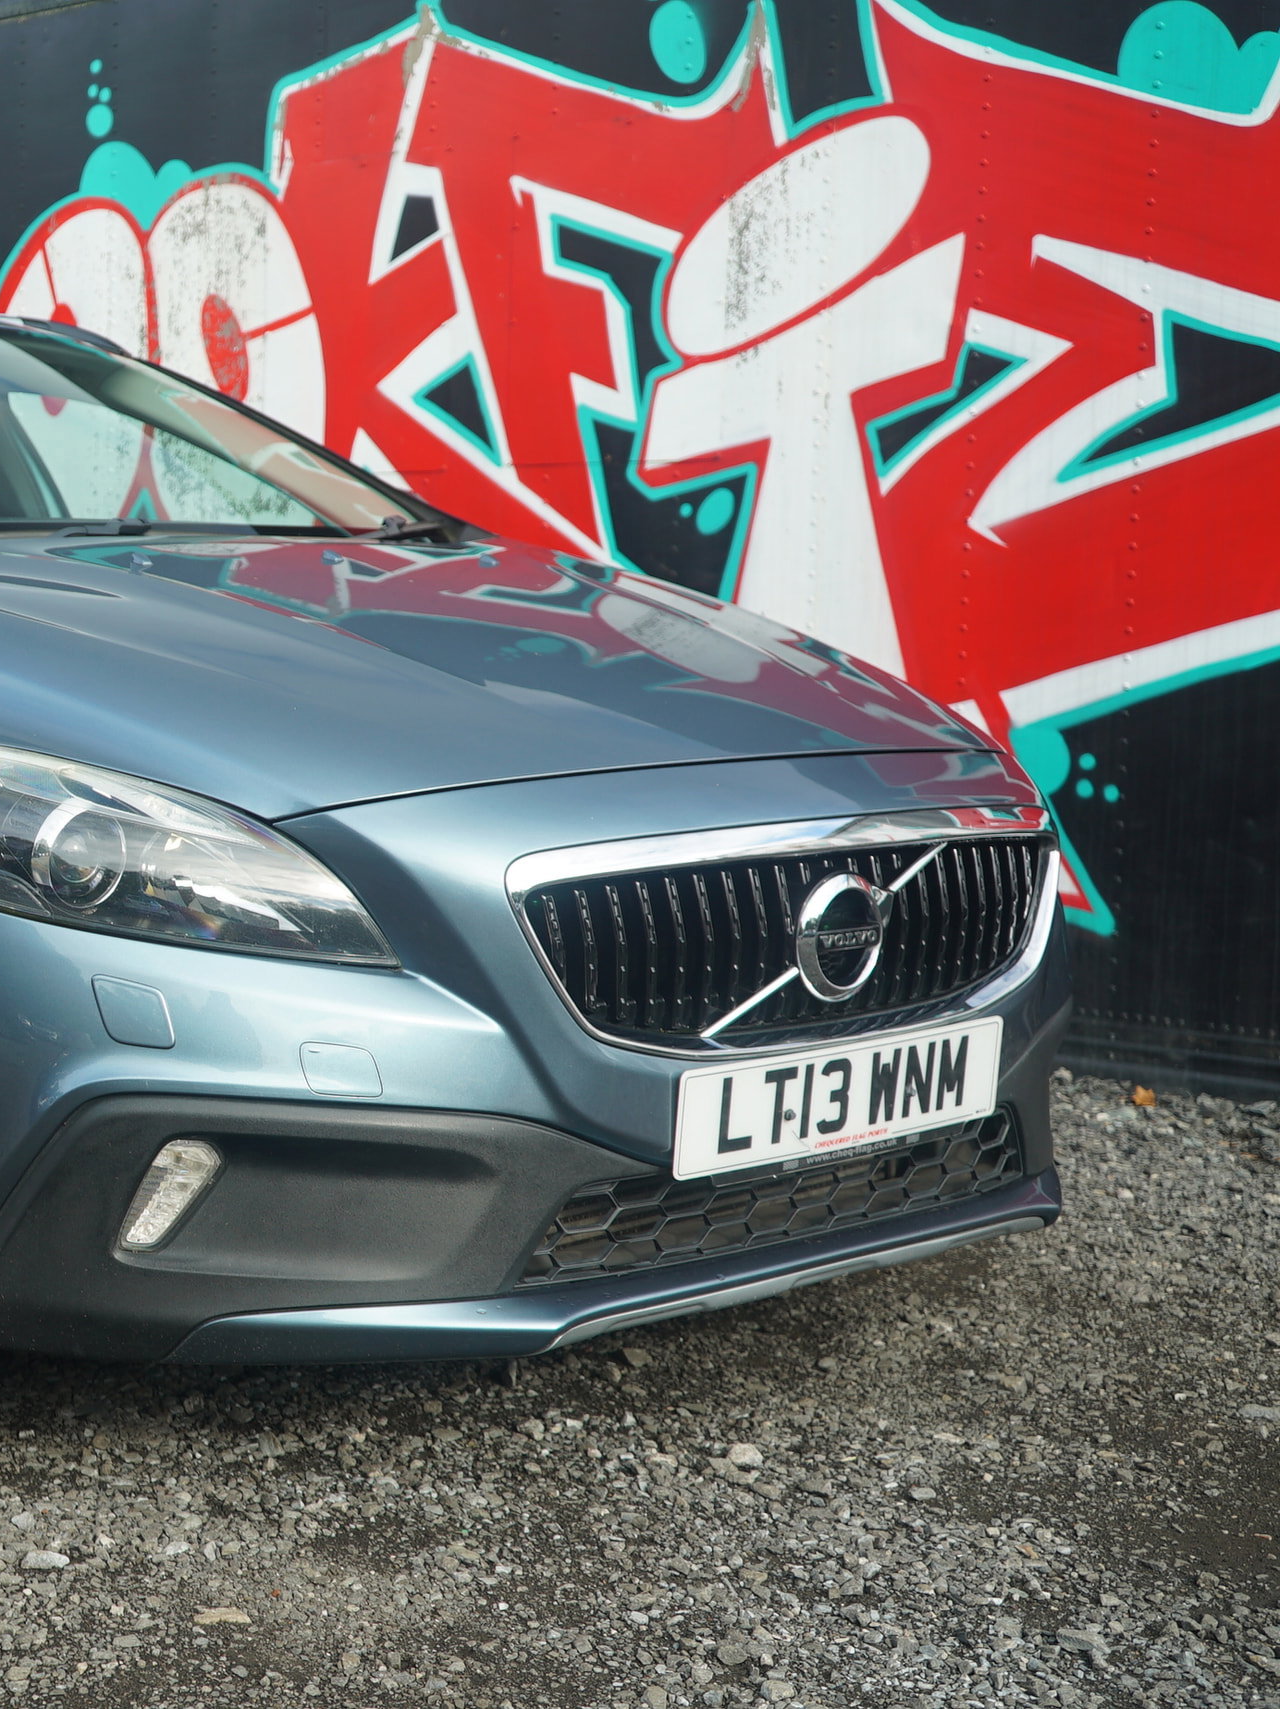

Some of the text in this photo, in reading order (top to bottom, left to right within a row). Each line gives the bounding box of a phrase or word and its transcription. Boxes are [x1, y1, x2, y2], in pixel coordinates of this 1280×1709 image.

[819, 929, 878, 949] VOLVO
[717, 1035, 969, 1154] LT13 WNM
